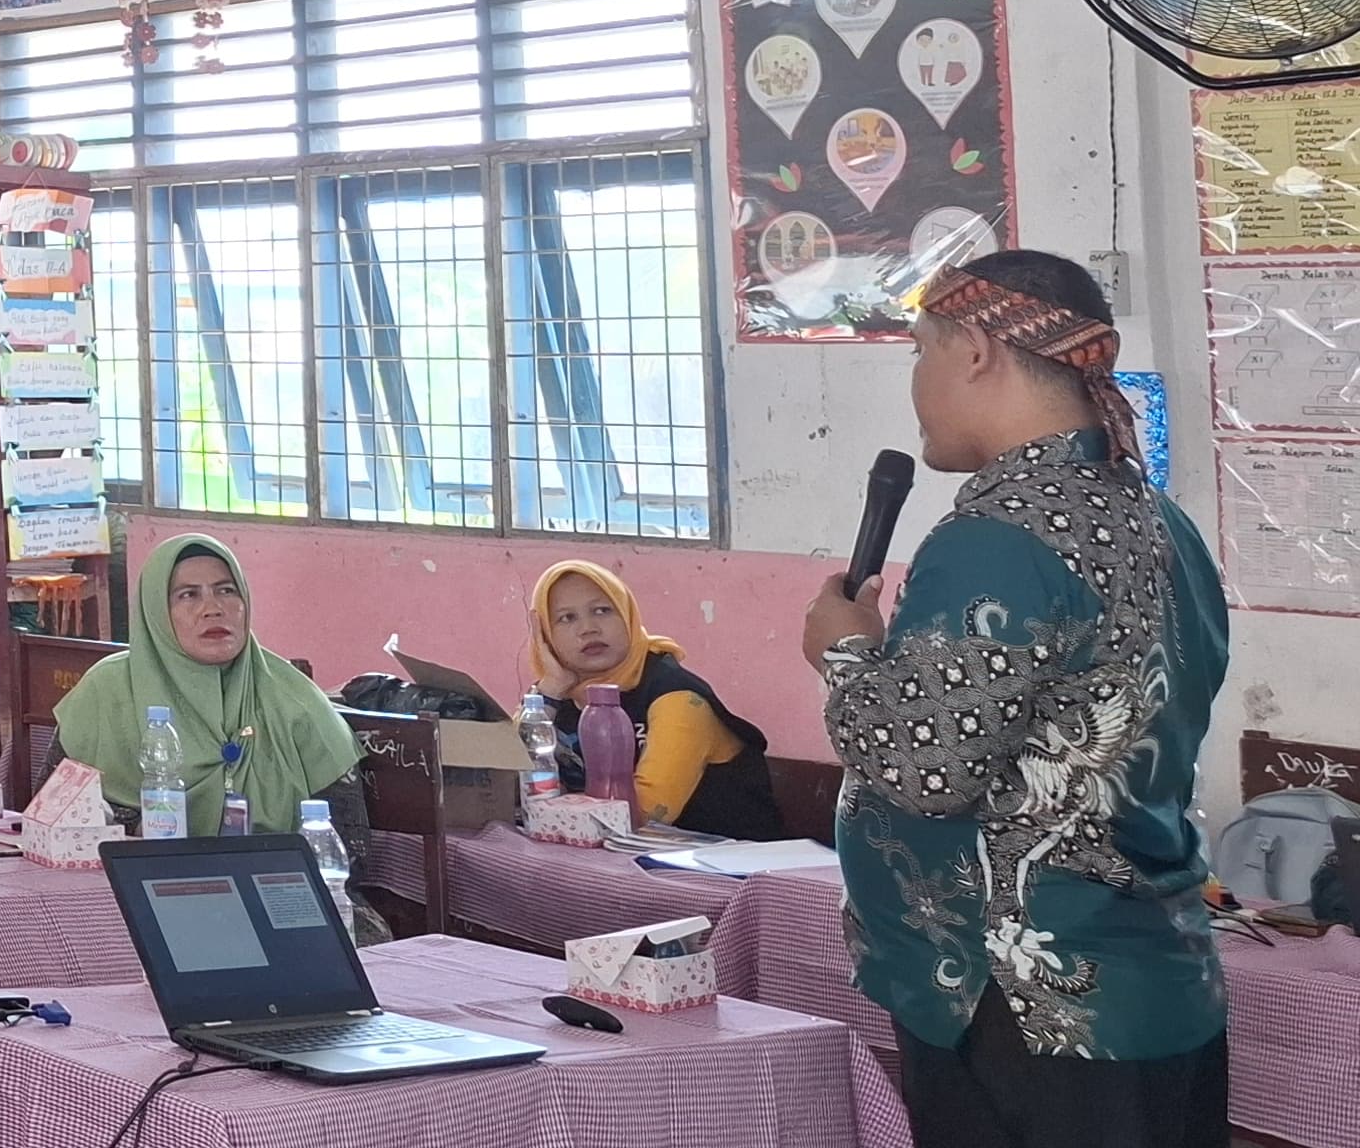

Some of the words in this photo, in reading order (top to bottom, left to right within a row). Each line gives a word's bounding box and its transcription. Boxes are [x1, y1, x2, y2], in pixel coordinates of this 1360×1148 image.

[1290, 92, 1317, 101] Kelas
[1260, 270, 1291, 280] Denah
[1302, 270, 1329, 280] Kelas
